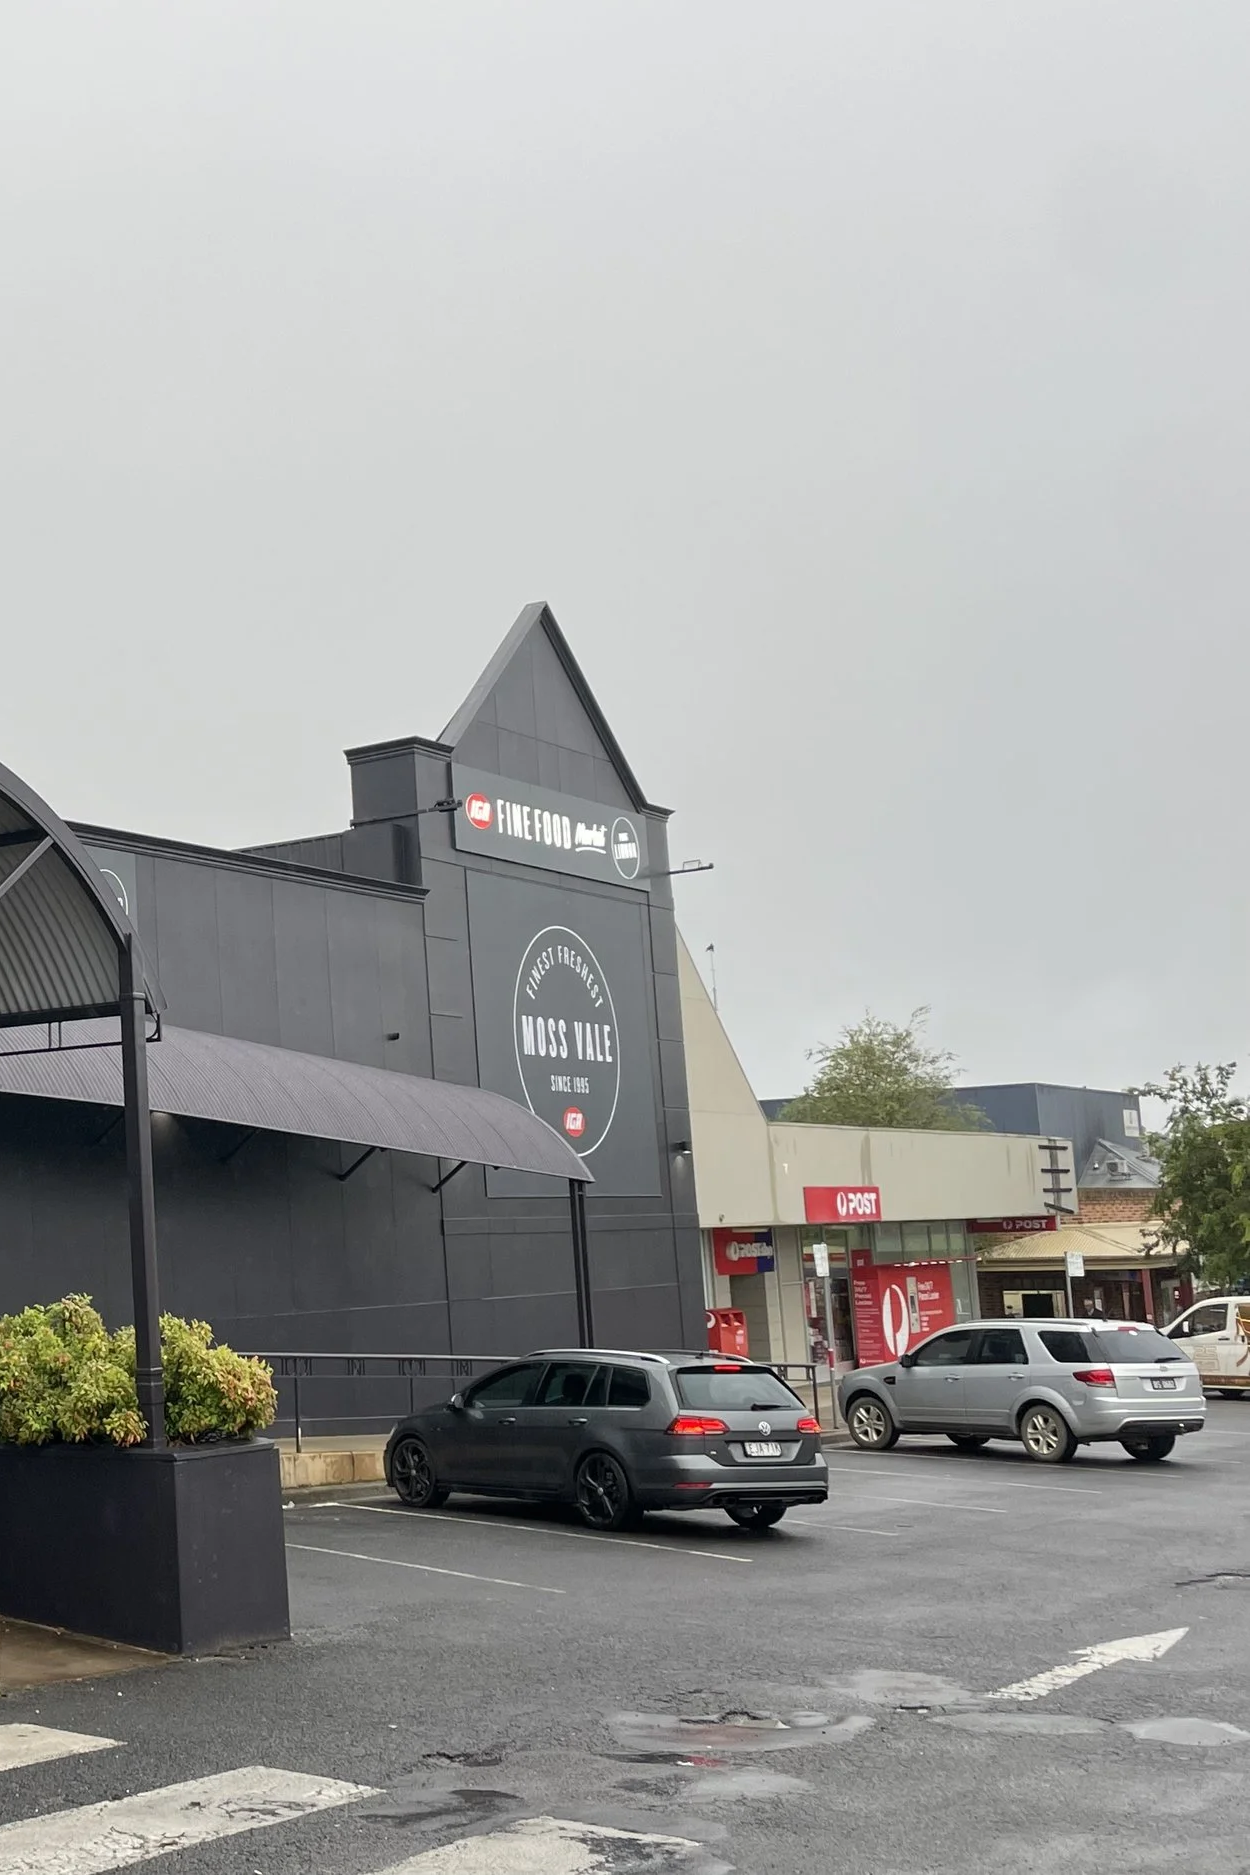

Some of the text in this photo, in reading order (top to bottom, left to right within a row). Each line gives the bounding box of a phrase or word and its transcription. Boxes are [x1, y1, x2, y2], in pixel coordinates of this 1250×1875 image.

[470, 798, 607, 850] IGA FINE FOOD Market
[525, 945, 604, 1008] FINEST FRESHEST
[521, 1014, 613, 1063] MOSS VALE
[550, 1074, 590, 1094] SINCE 1995
[565, 1112, 584, 1131] IGA
[847, 1192, 877, 1215] POST
[1015, 1219, 1047, 1230] POST
